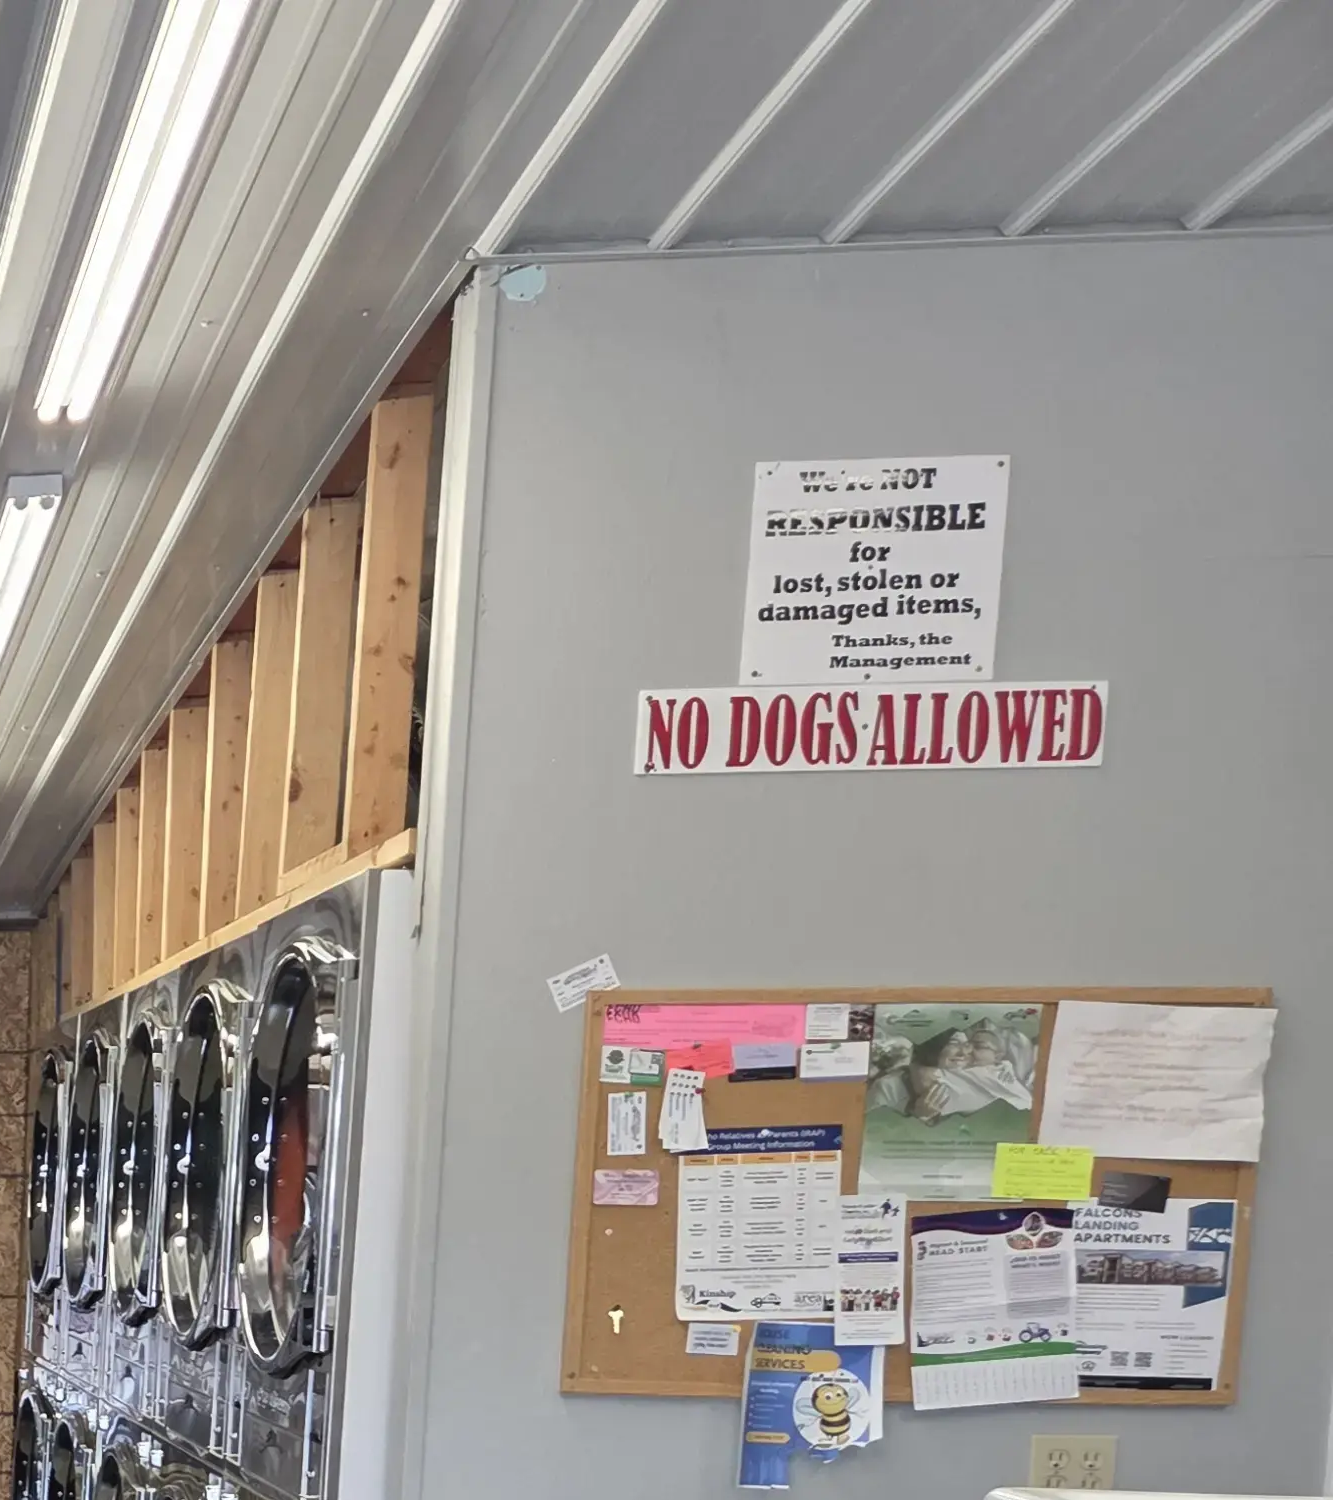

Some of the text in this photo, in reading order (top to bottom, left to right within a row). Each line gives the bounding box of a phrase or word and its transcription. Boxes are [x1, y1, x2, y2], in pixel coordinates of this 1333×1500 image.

[880, 468, 937, 490] NOT
[765, 502, 986, 537] RESPONSIBLE
[849, 541, 891, 563] for
[773, 568, 960, 597] lost, stolen or
[758, 594, 982, 625] damaged items,
[831, 631, 953, 649] Thanks, the
[829, 653, 972, 670] Management
[646, 688, 1104, 770] NO DOGS ALLOWED
[1074, 1207, 1143, 1218] FALCONS
[1074, 1221, 1140, 1231] LANDING
[1074, 1233, 1171, 1244] APARTMENTS
[755, 1358, 806, 1370] SERVICES
